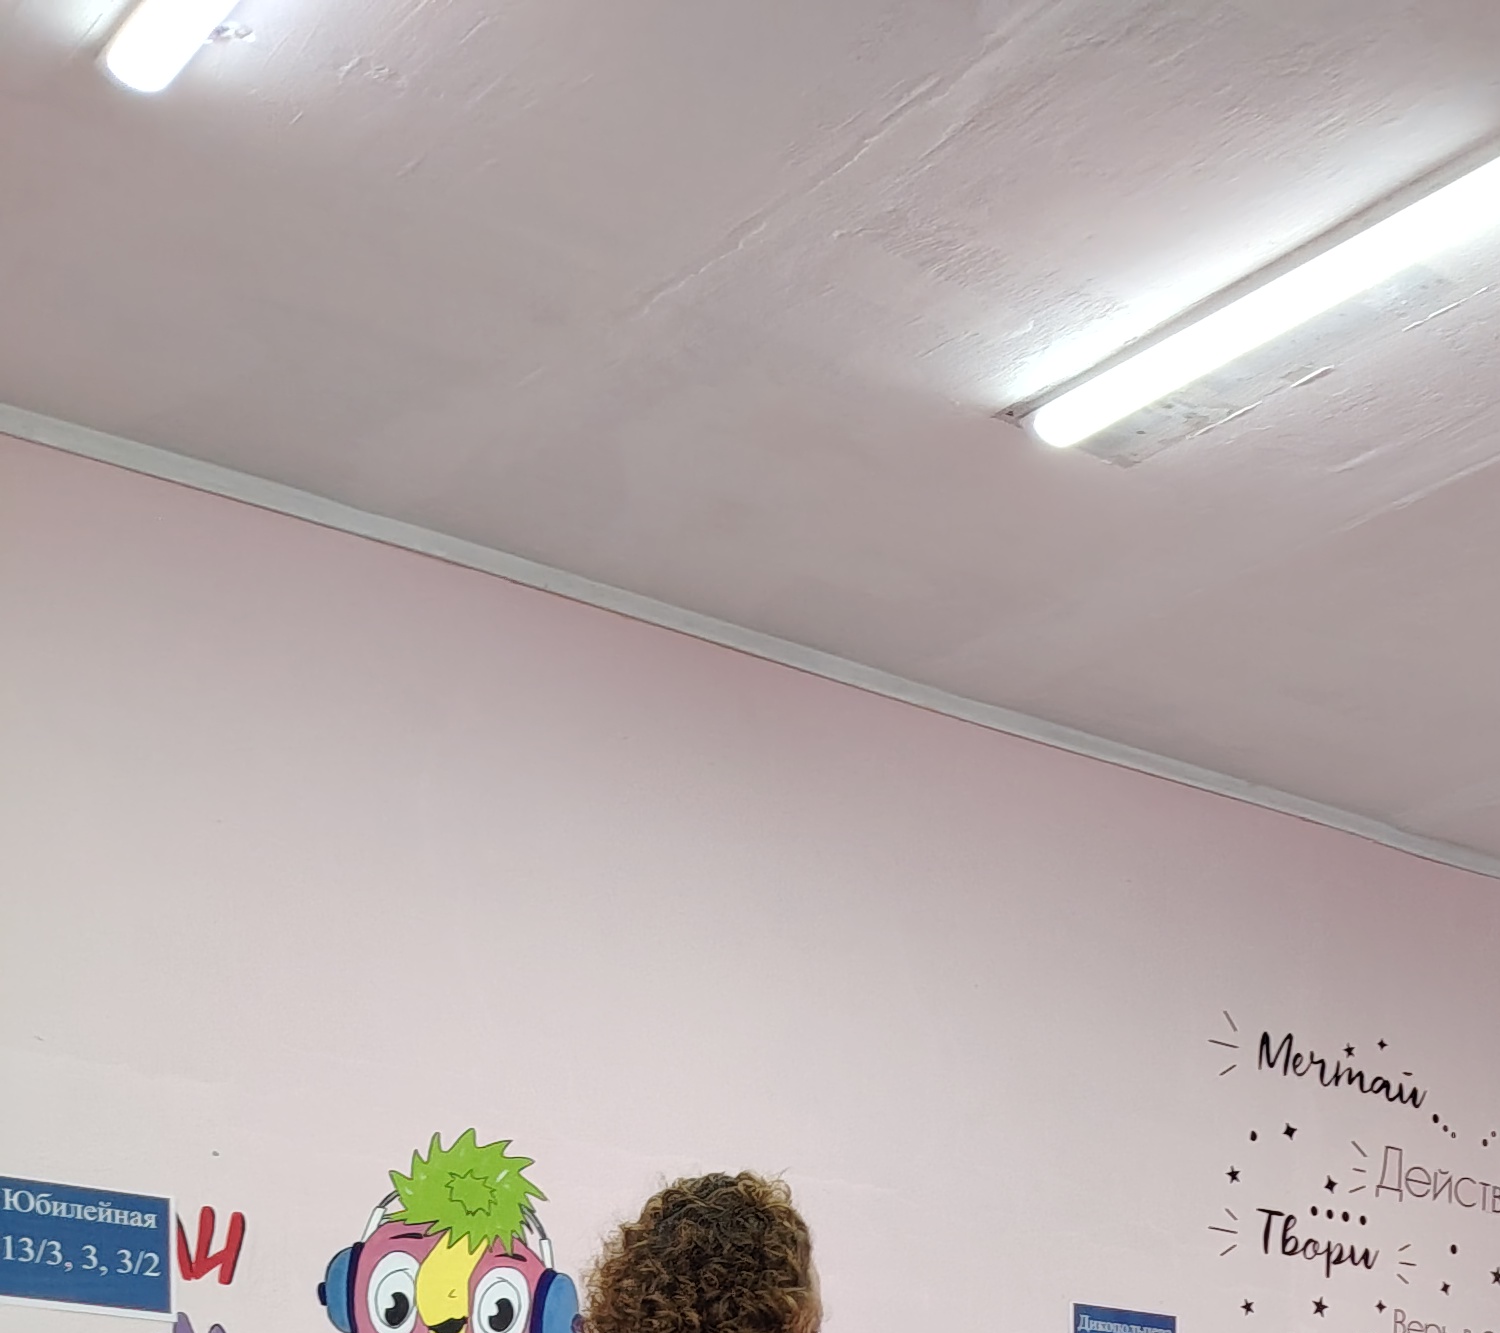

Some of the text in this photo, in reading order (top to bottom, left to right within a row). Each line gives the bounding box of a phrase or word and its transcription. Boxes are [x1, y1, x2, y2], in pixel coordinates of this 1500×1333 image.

[1257, 1031, 1428, 1109] Мечтай
[2, 1188, 158, 1229] Юбилейная
[2, 1235, 162, 1277] 13/3, 3, 3/2
[1256, 1208, 1380, 1278] Твори
